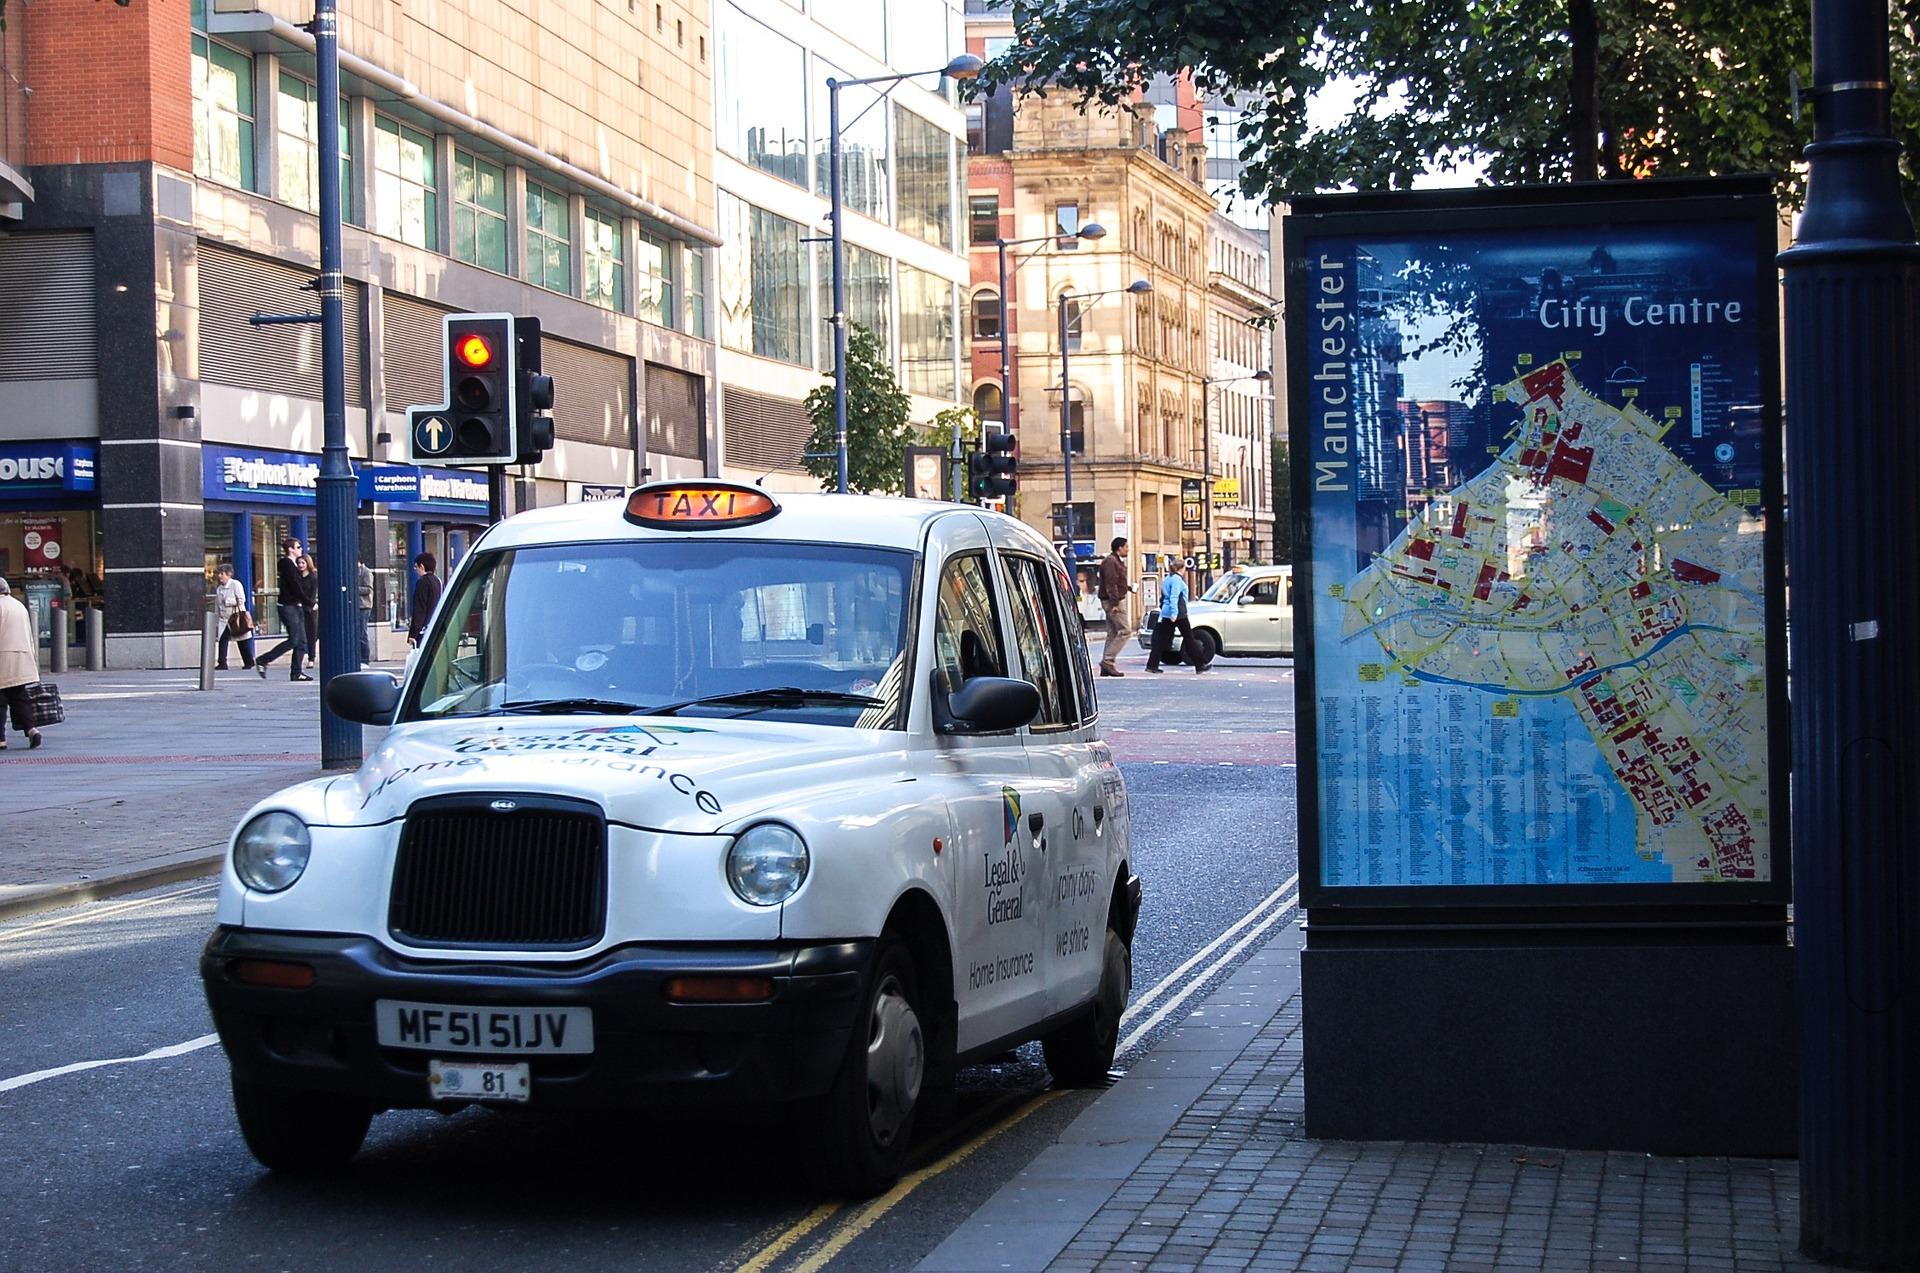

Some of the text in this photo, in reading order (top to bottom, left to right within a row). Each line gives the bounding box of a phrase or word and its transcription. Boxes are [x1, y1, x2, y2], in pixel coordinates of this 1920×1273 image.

[1539, 297, 1742, 336] City Centre
[1314, 253, 1349, 492] Manchester
[378, 475, 417, 484] Carphone
[654, 492, 736, 517] TAXI
[455, 743, 658, 756] General
[360, 756, 482, 810] Home
[1072, 807, 1084, 840] On
[984, 851, 1011, 895] Legal
[1058, 863, 1096, 906] rainy days
[987, 886, 1023, 926] General
[1056, 924, 1089, 958] we shine
[969, 951, 1034, 991] Home Insurance
[482, 1071, 505, 1092] 81
